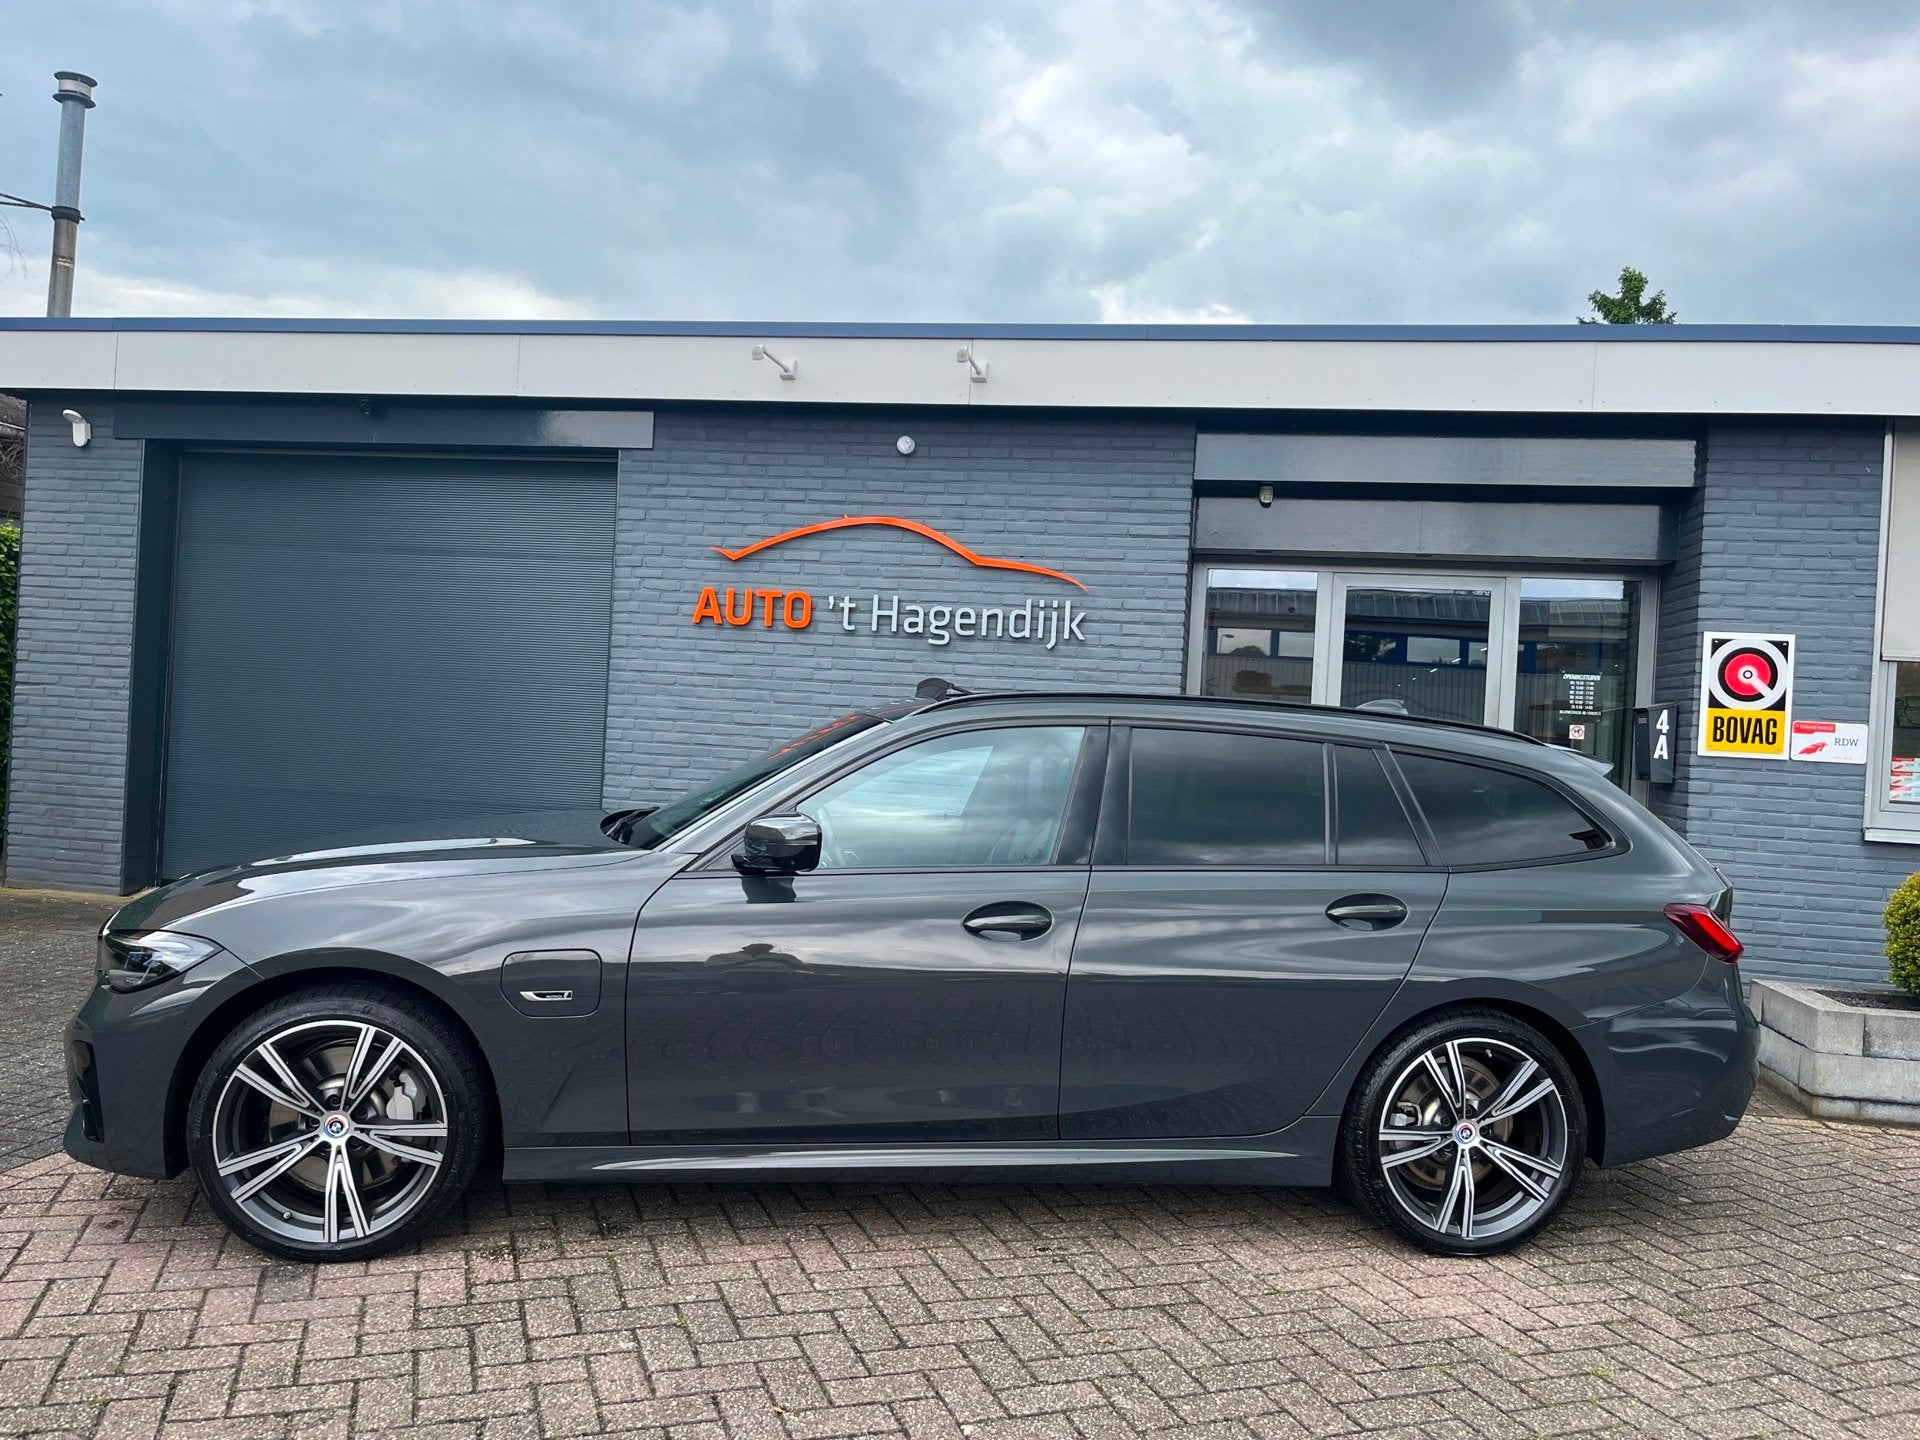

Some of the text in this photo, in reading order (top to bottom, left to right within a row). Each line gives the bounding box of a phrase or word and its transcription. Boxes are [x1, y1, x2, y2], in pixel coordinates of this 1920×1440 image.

[692, 586, 812, 629] AUTO
[871, 594, 1087, 650] Hagendijk
[1656, 709, 1670, 734] 4
[1712, 715, 1778, 746] BOVAG
[1653, 734, 1669, 760] A
[1834, 737, 1859, 747] RDW
